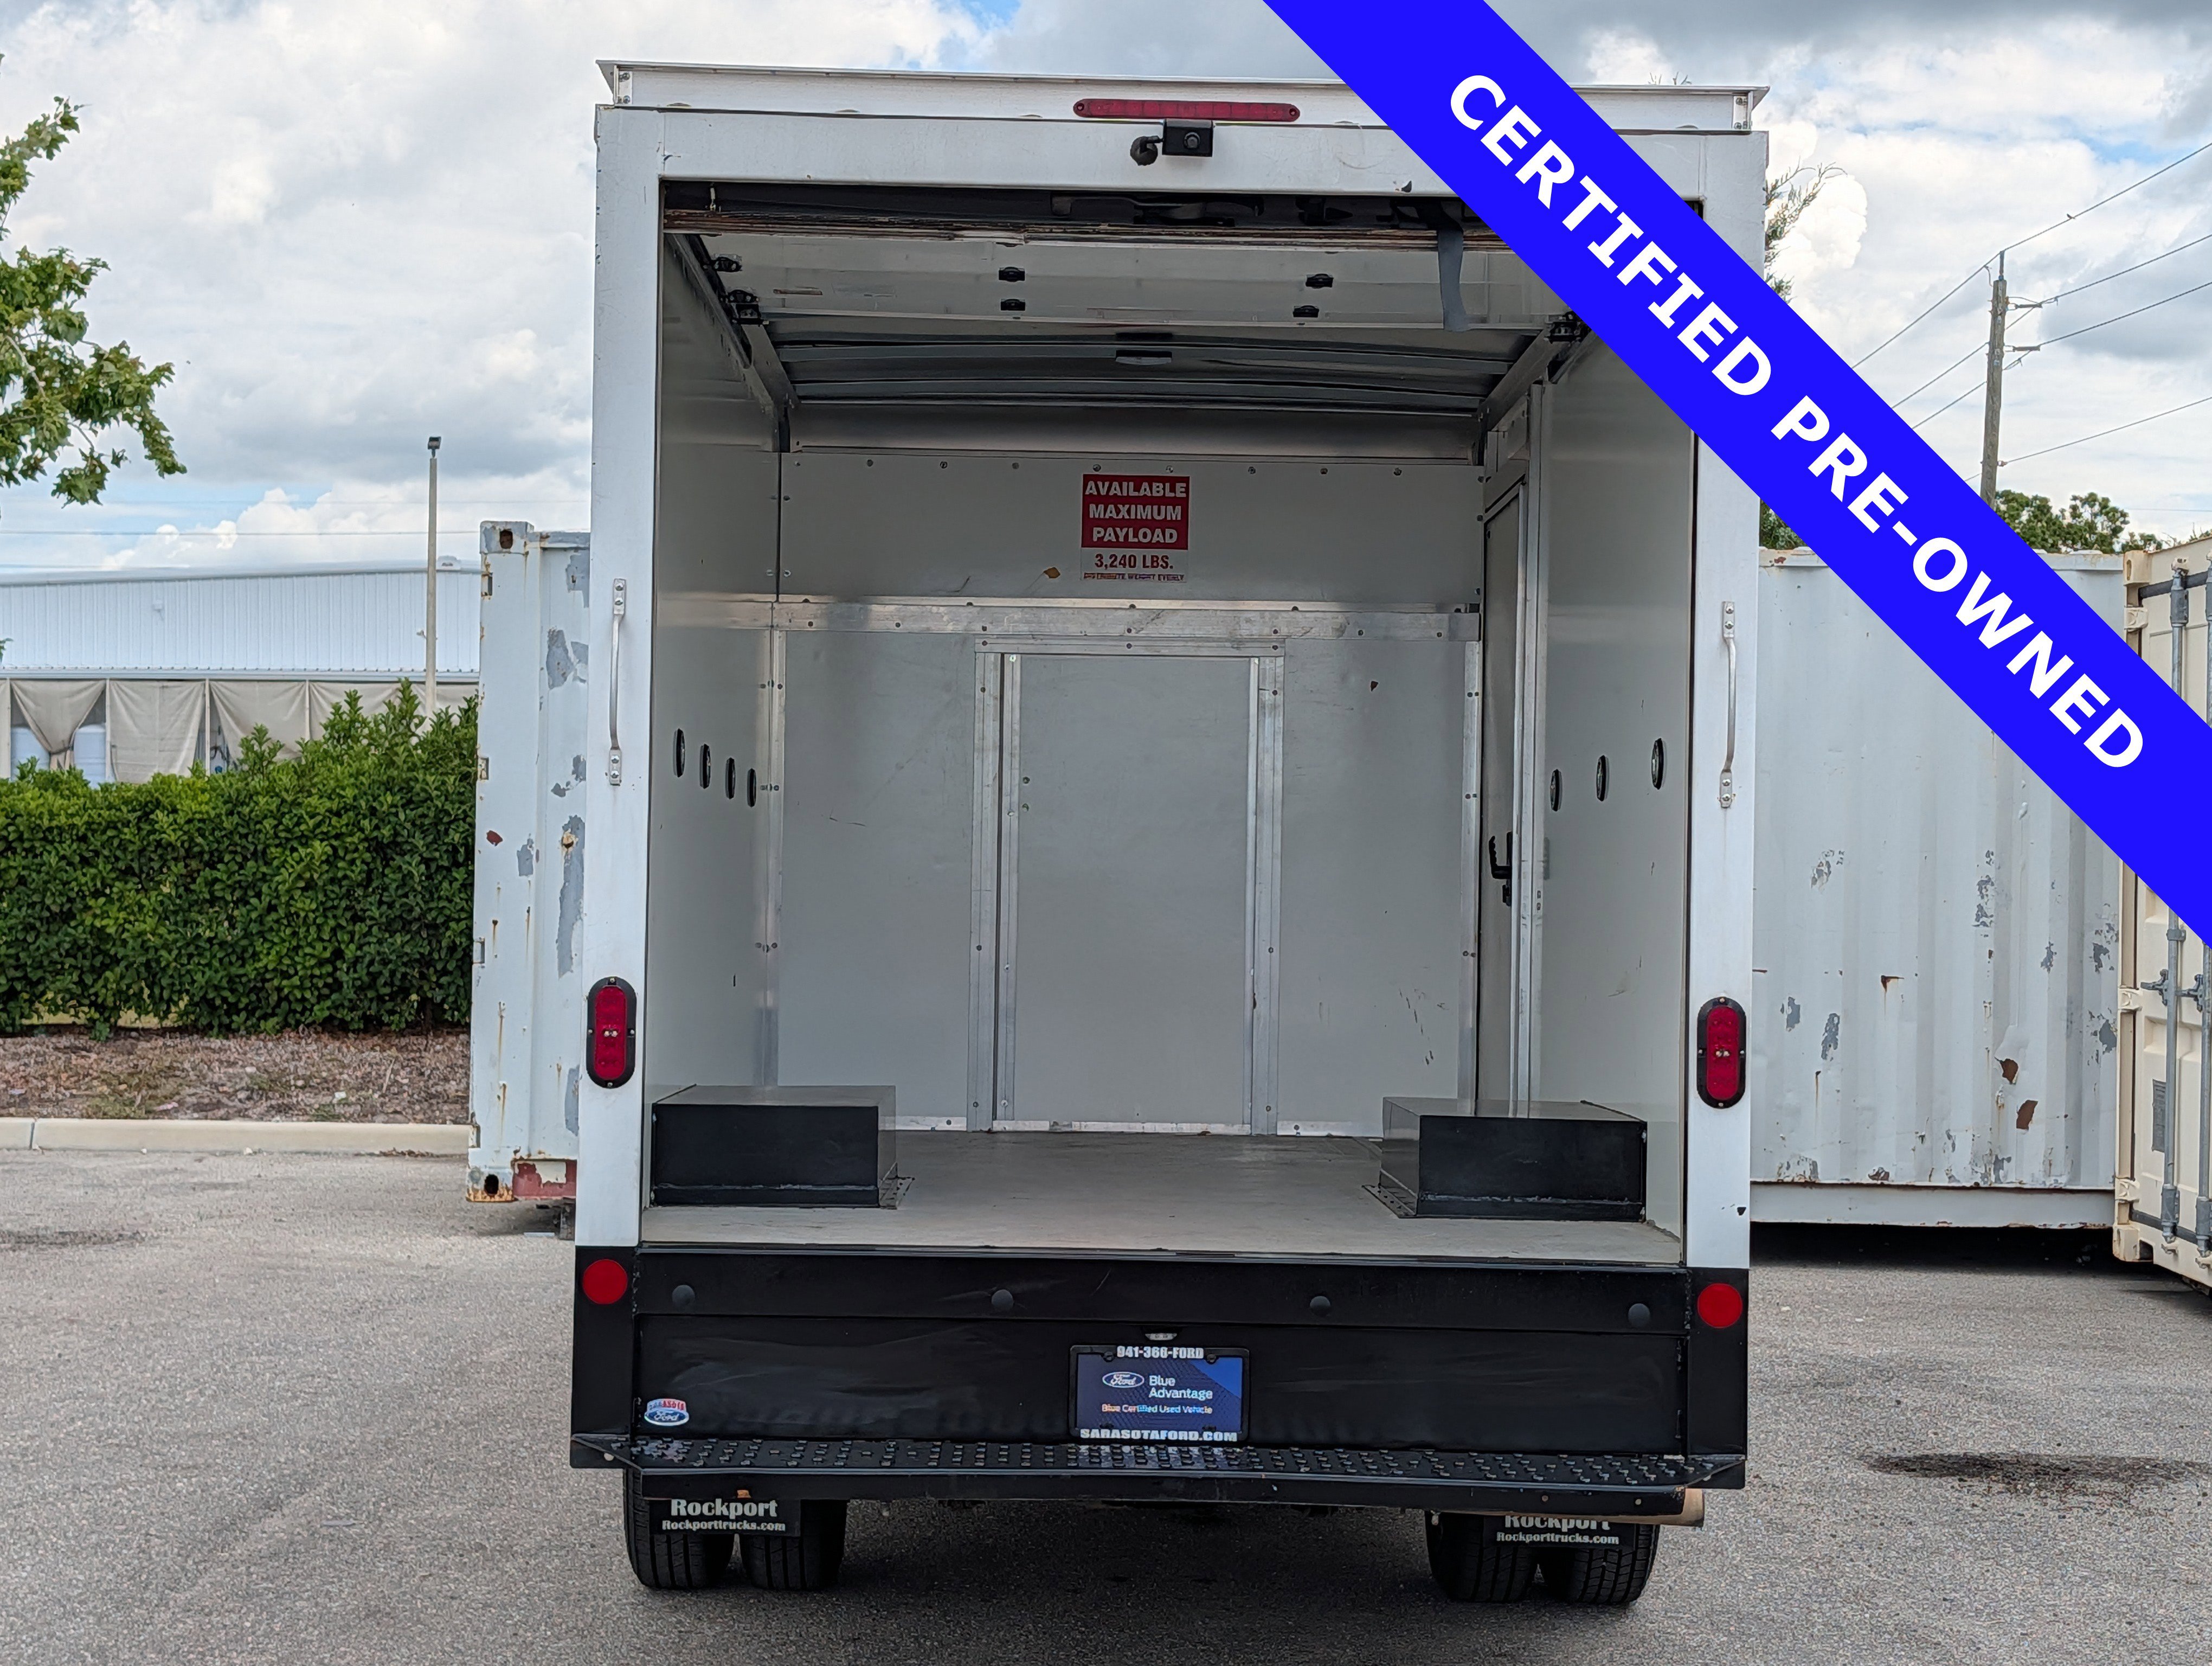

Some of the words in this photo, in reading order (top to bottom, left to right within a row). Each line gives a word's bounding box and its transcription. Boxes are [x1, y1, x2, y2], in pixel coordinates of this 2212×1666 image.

[1085, 480, 1187, 497] AVAILABLE
[1089, 503, 1181, 520] MAXIMUM
[1092, 527, 1178, 543] PAYLOAD
[1095, 553, 1137, 569] 3,240
[1142, 554, 1173, 569] LBS.
[1110, 1374, 1137, 1386] Ford
[1149, 1375, 1175, 1386] Blue
[1148, 1387, 1213, 1401] Advantage
[1102, 1404, 1121, 1412] Blue
[1159, 1405, 1181, 1413] Used
[1182, 1406, 1212, 1414] Vehicle
[1080, 1428, 1237, 1442] SARASOTAFORD.COM
[671, 1498, 777, 1519] Rockport
[662, 1520, 786, 1532] Rockporttrucks.com
[1496, 1532, 1619, 1545] Rockporttrucks.com
